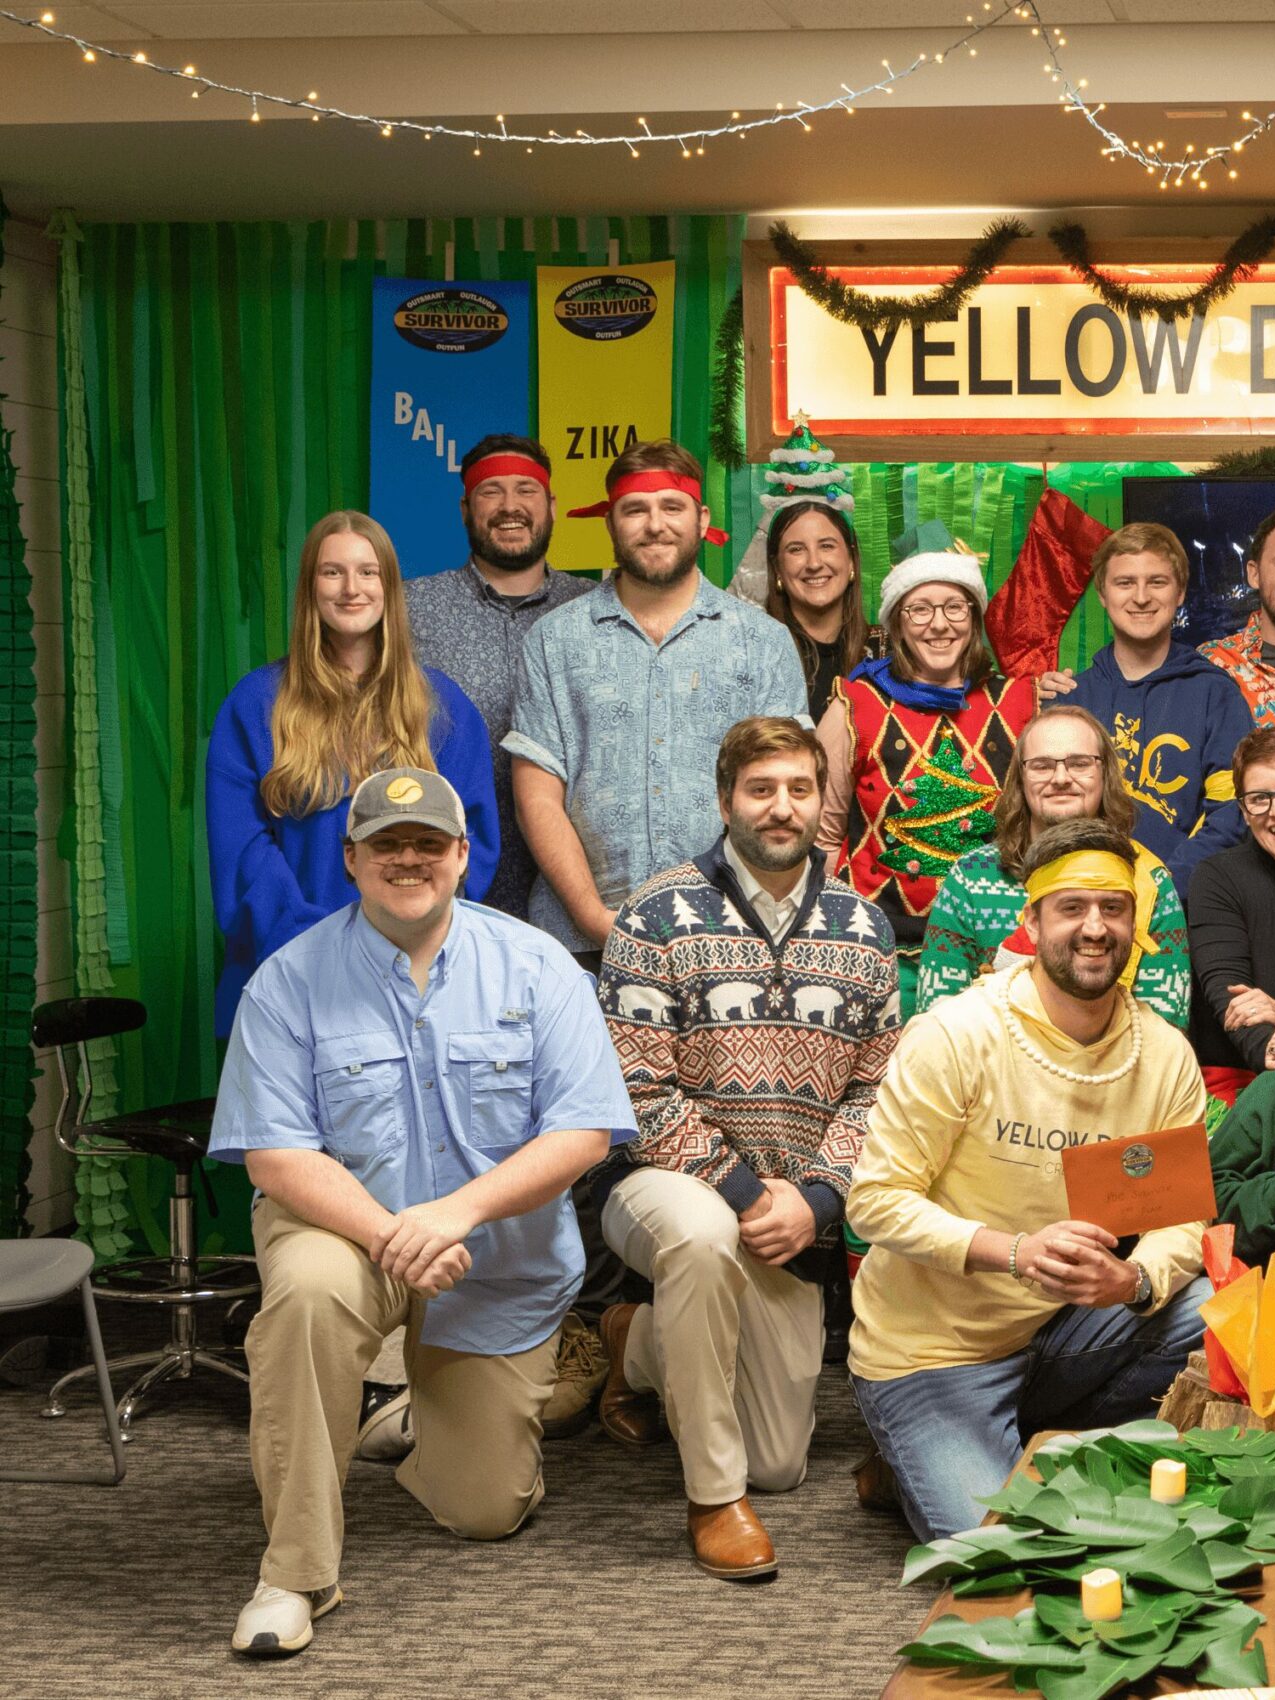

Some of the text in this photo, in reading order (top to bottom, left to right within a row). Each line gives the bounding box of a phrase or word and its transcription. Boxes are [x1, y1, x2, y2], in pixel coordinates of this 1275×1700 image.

[565, 277, 648, 297] OUTSMART OUTLAUGH
[406, 291, 497, 311] OUTSMART OUTLAUGH
[565, 298, 650, 316] SURVIVOR
[404, 314, 499, 329] SURVIVOR
[860, 302, 1207, 397] YELLOW
[996, 1118, 1089, 1151] YELLOW
[1044, 1161, 1064, 1176] CR
